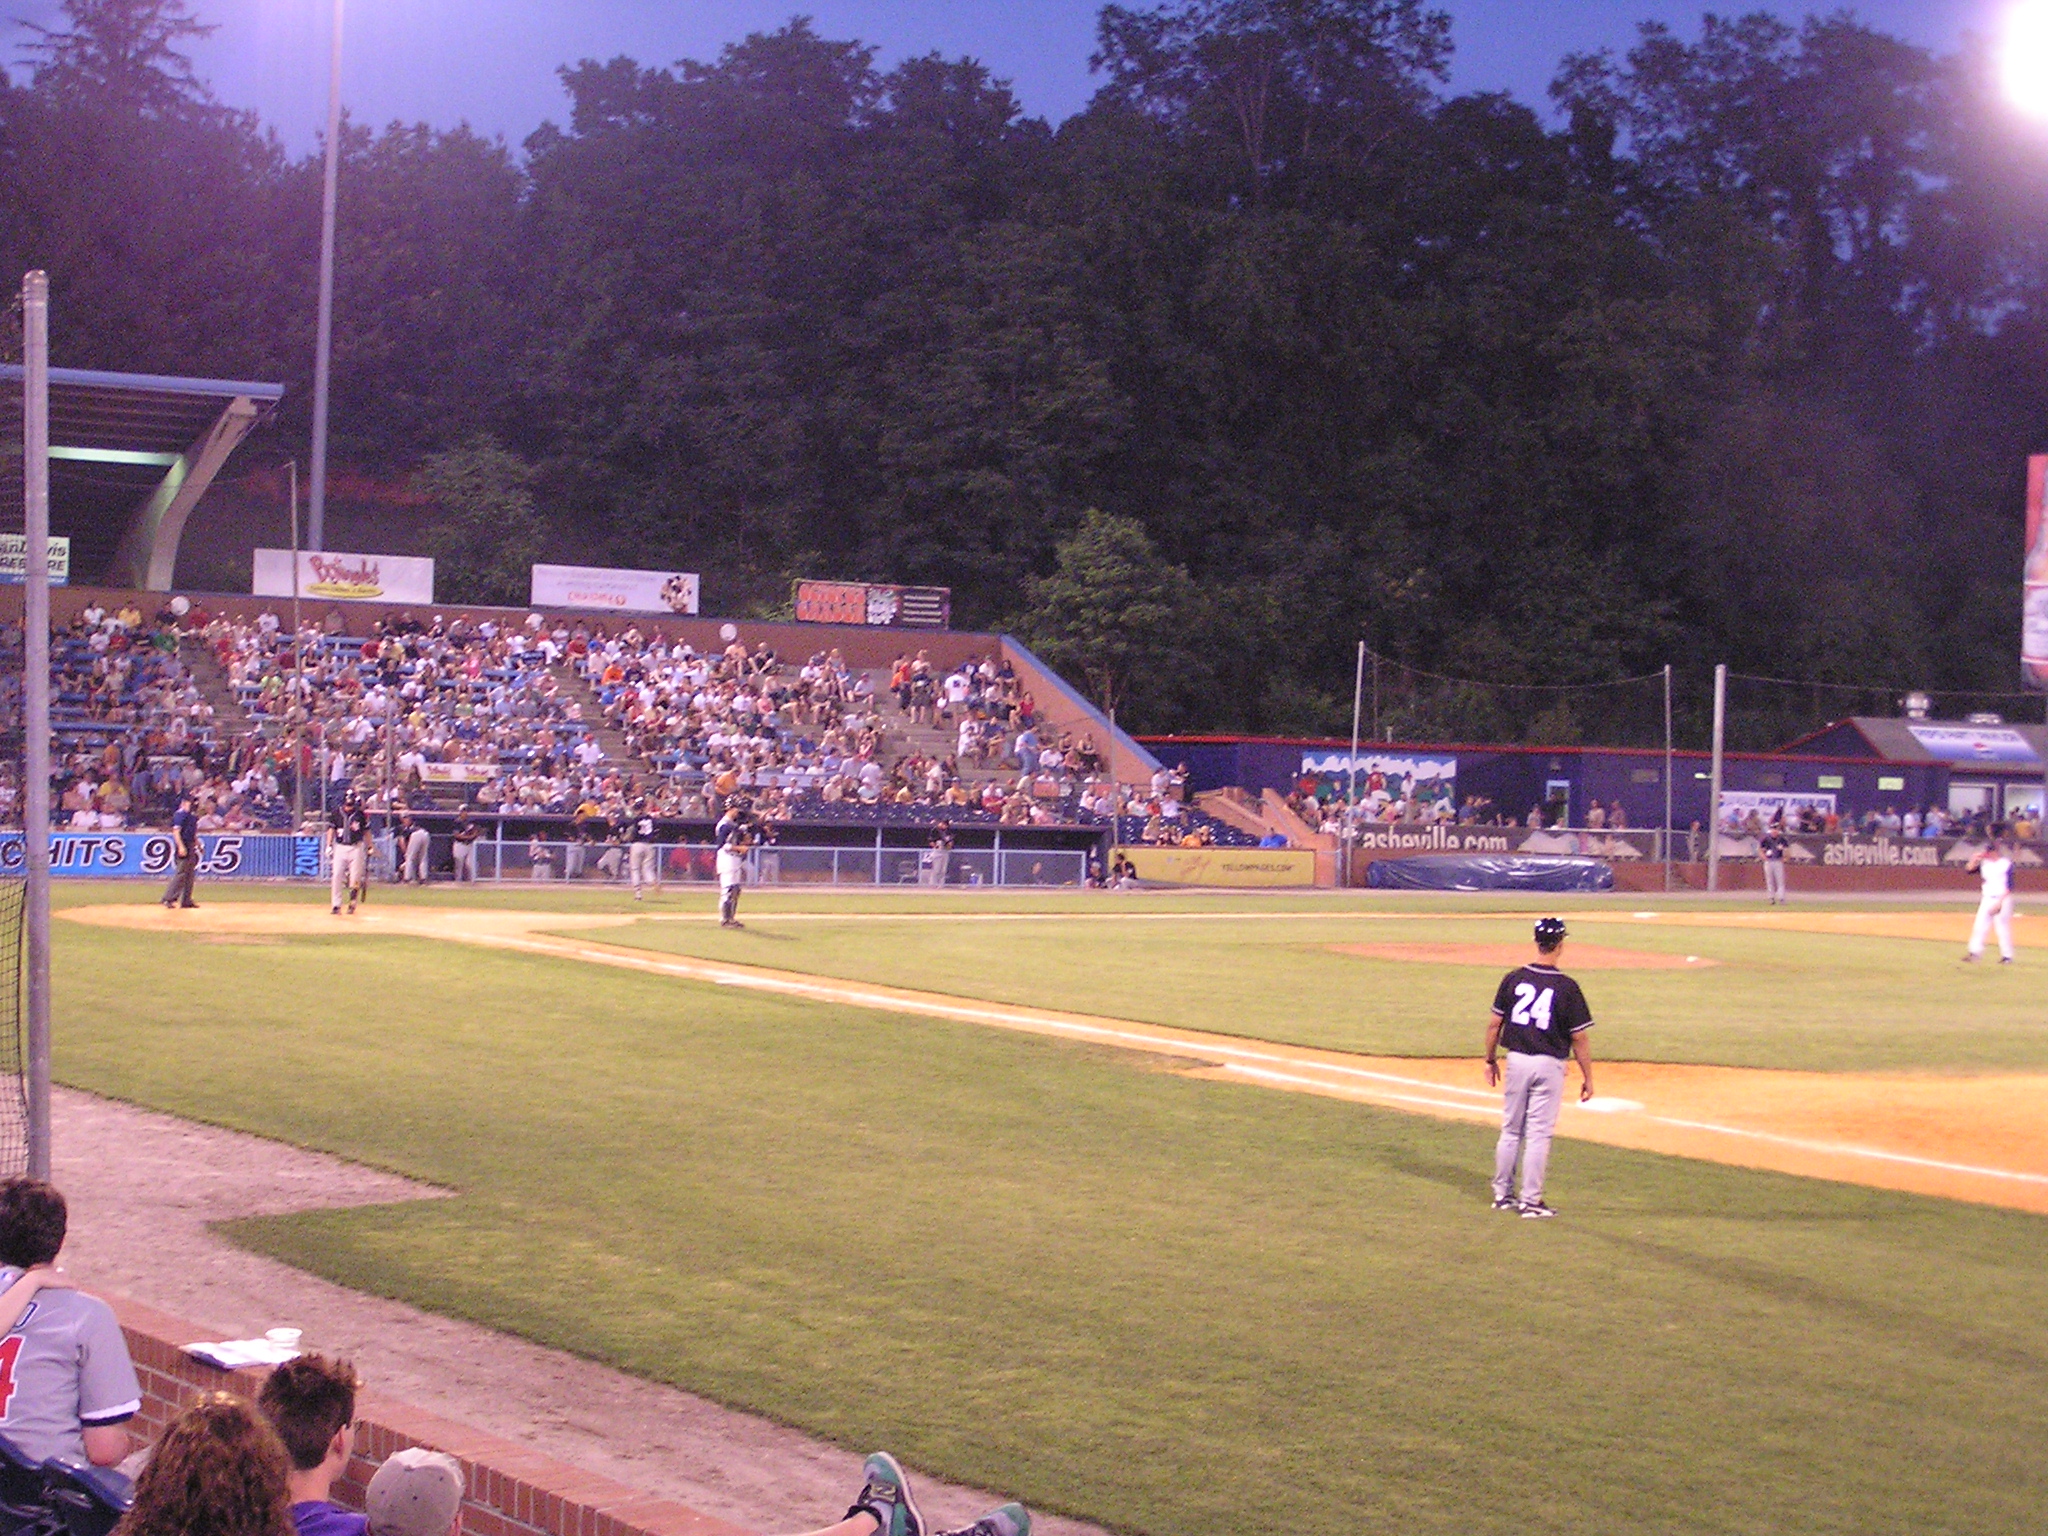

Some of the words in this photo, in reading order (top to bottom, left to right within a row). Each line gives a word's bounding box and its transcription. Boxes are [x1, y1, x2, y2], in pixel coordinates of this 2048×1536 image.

[140, 836, 244, 873] 9.5
[295, 836, 319, 877] ZONE
[1362, 825, 1509, 850] ashevillecom
[1511, 982, 1555, 1030] 24
